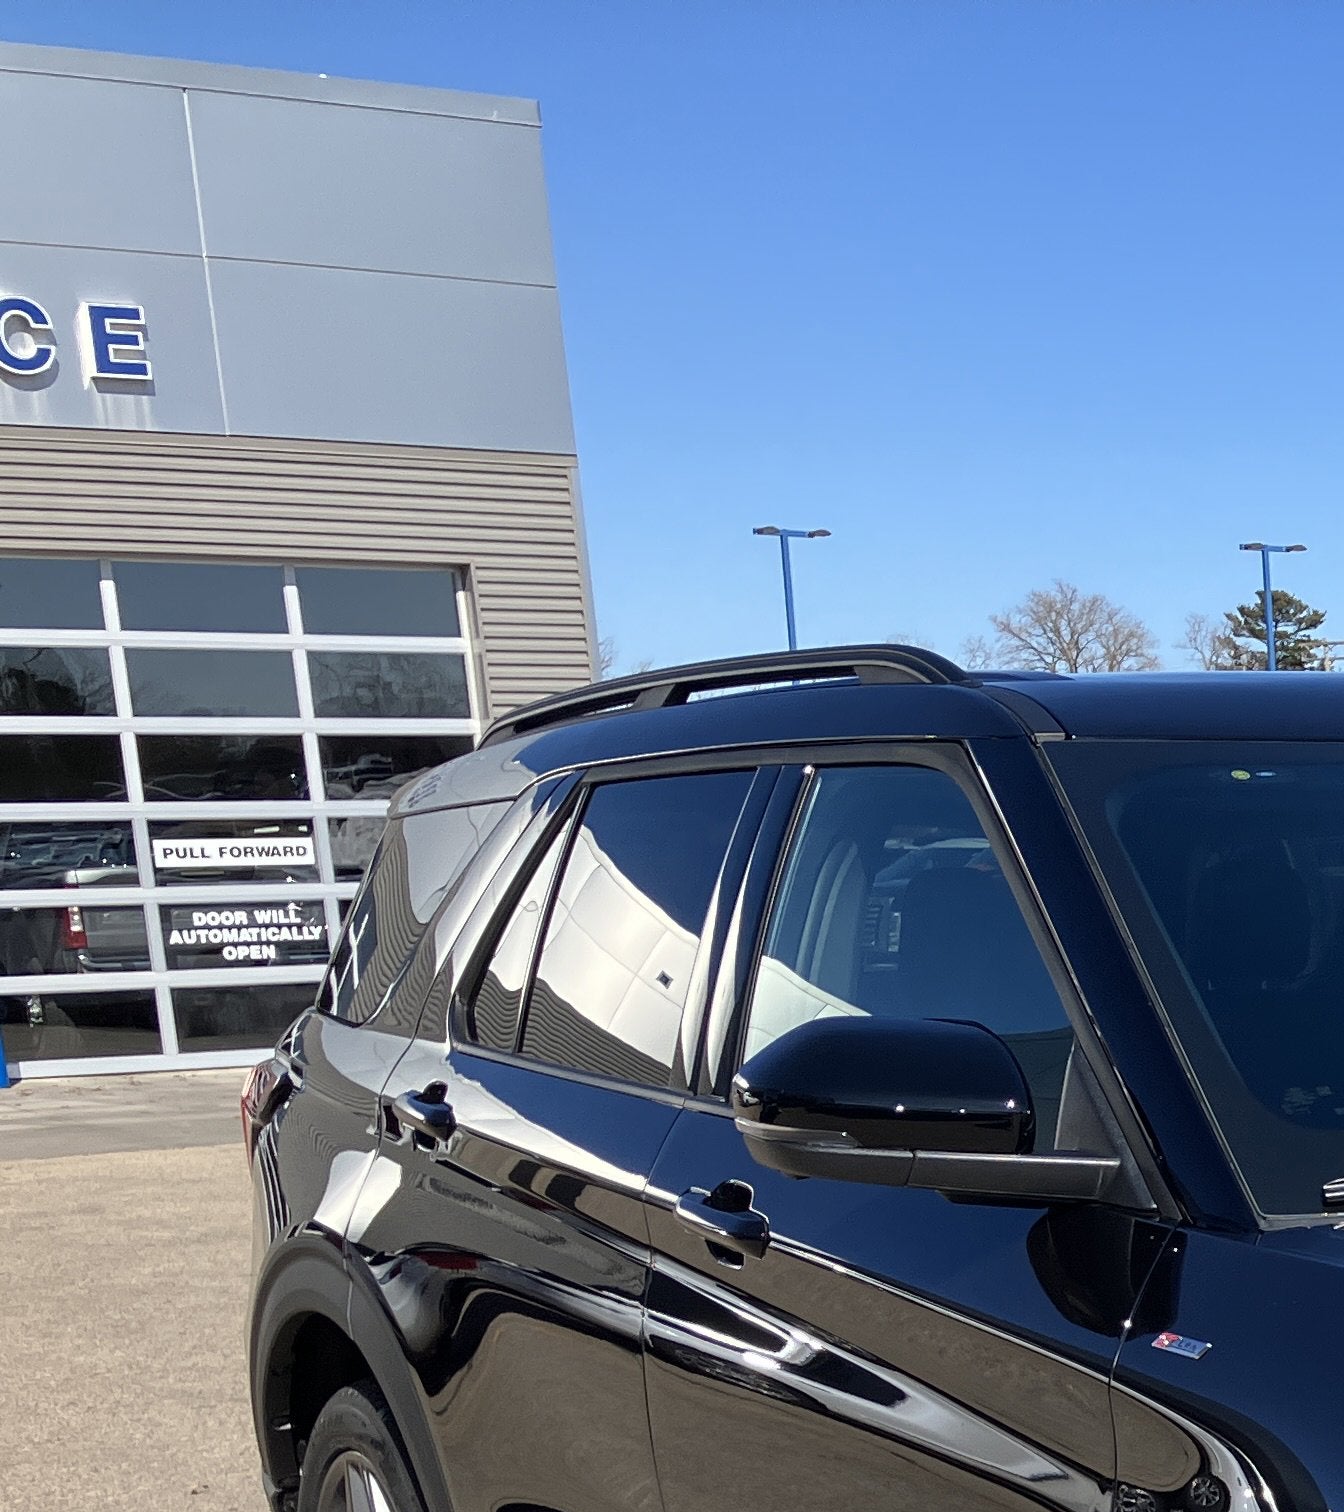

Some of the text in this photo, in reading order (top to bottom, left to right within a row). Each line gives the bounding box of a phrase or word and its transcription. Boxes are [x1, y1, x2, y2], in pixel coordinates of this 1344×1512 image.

[163, 845, 308, 859] PULL FORWARD
[192, 908, 302, 926] DOOR WILL
[169, 926, 322, 945] AUTOMATICALLY
[222, 944, 276, 960] OPEN
